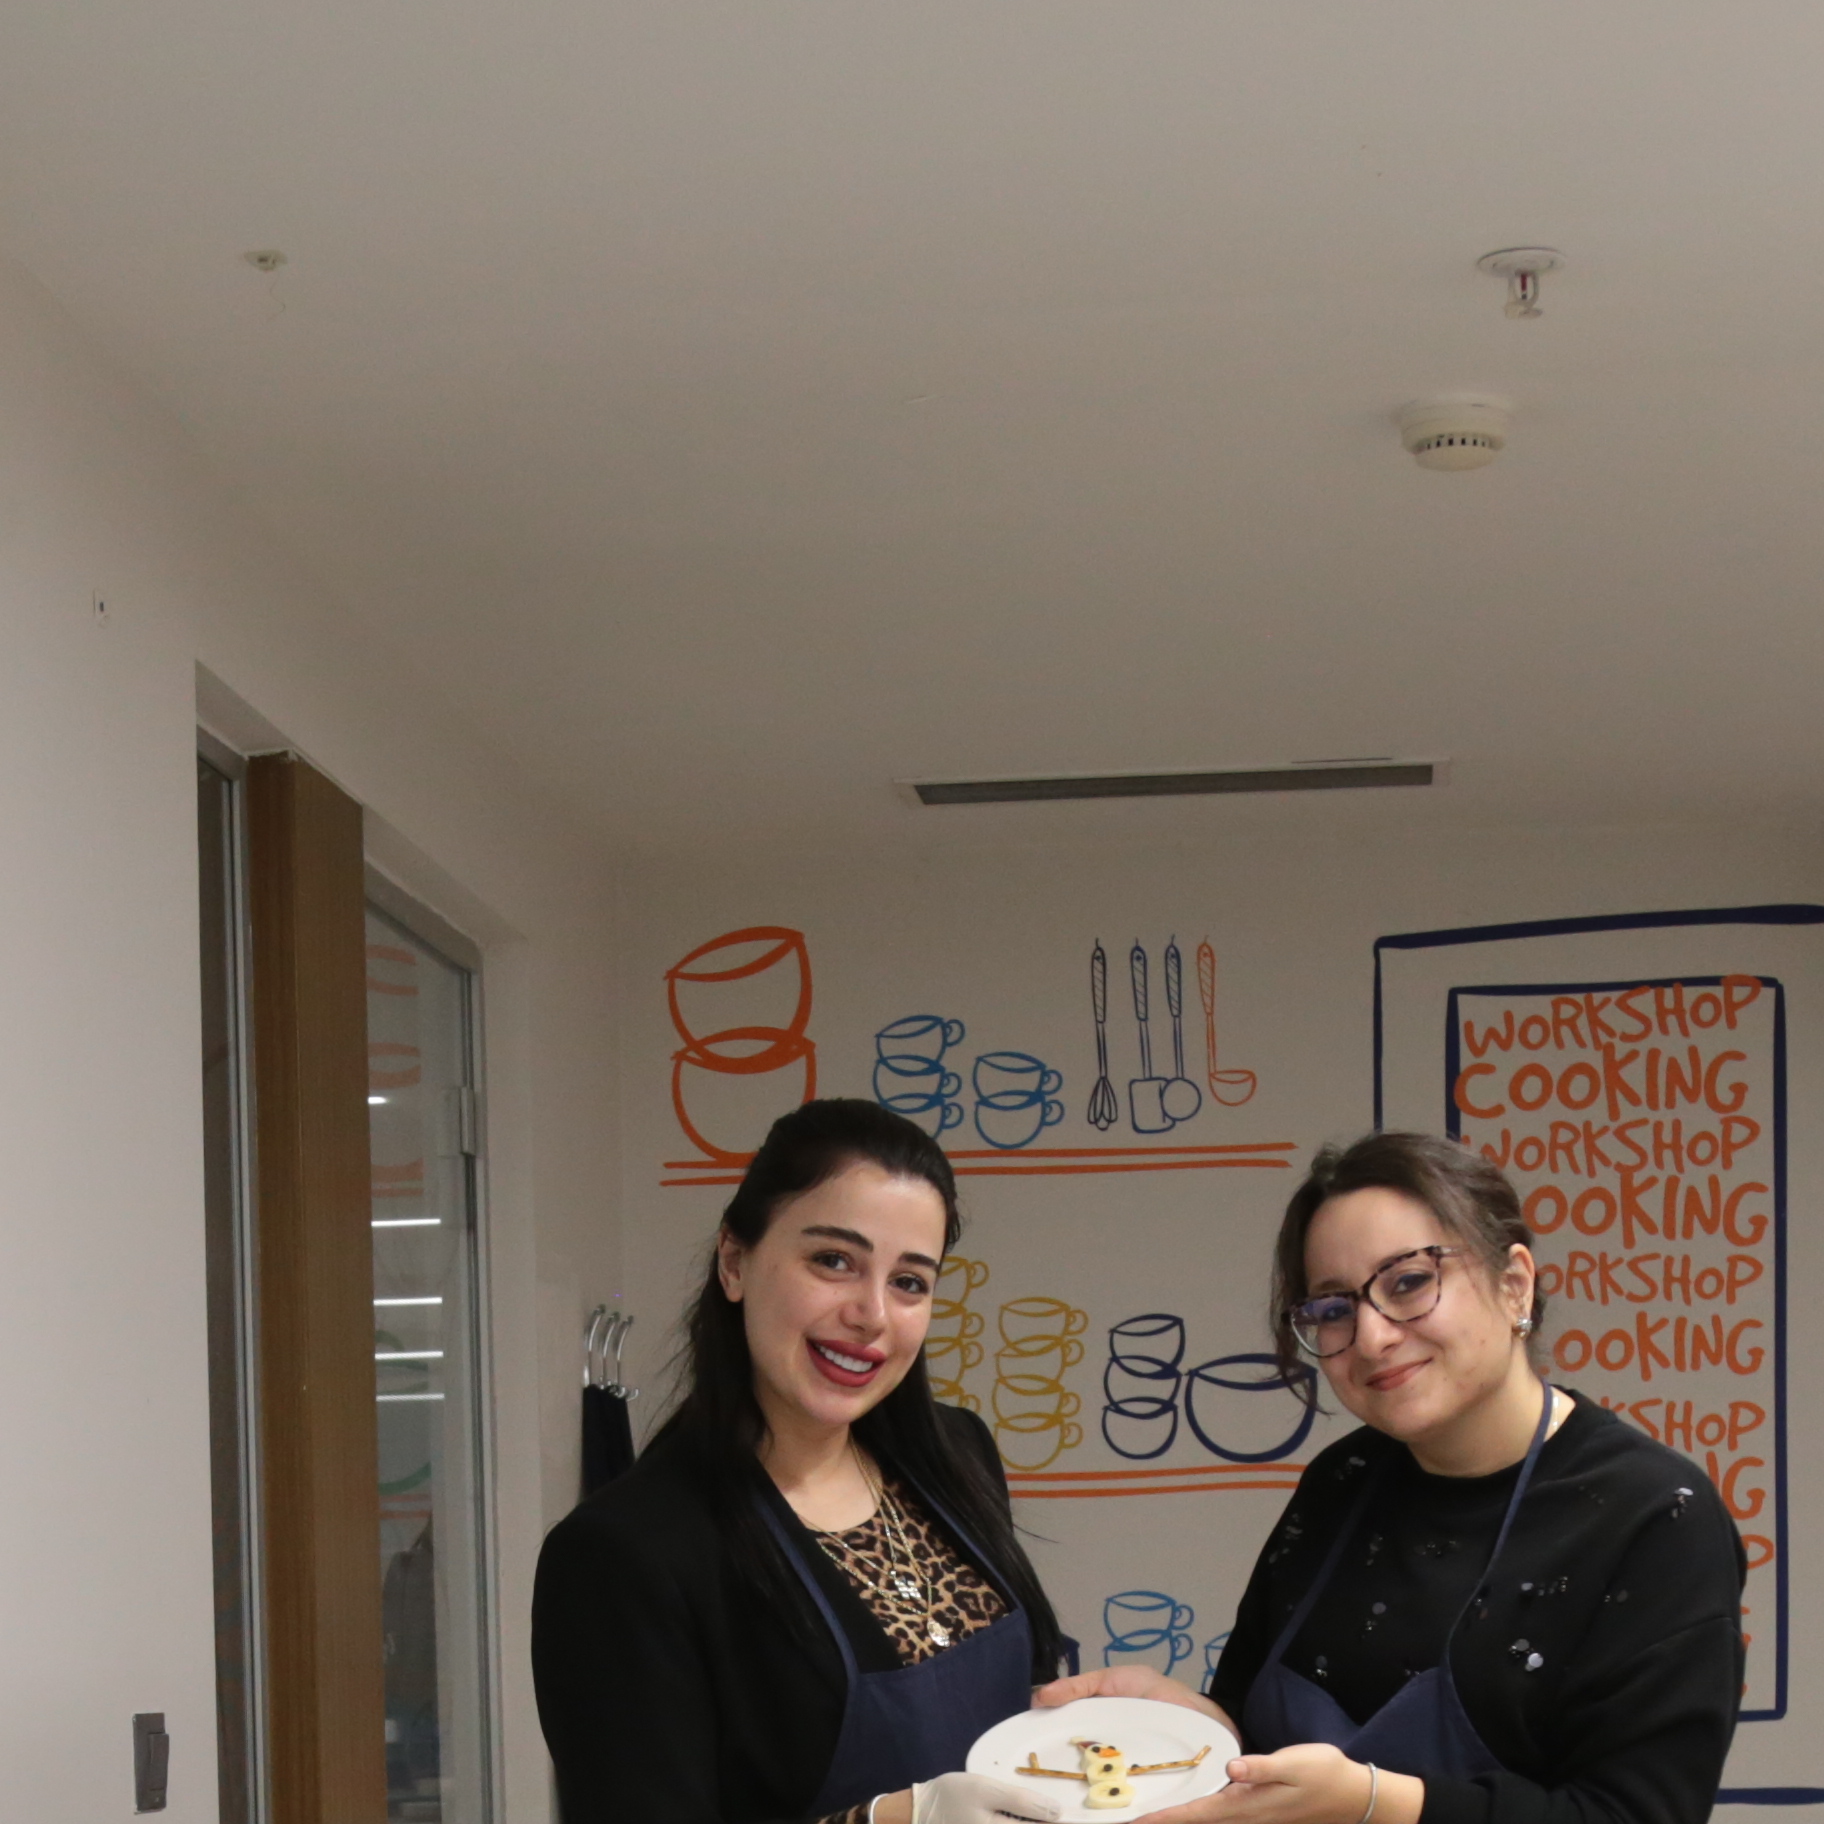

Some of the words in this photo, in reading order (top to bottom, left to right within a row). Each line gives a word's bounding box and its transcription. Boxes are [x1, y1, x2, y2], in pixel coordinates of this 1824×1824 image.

[1463, 973, 1763, 1058] WORKSHOP
[1453, 1041, 1749, 1122] COOKING
[1520, 1172, 1769, 1250] OOKING
[1536, 1250, 1764, 1307] ORKSHOP
[1539, 1311, 1766, 1382] OOKING
[1600, 1396, 1766, 1453] SHOP
